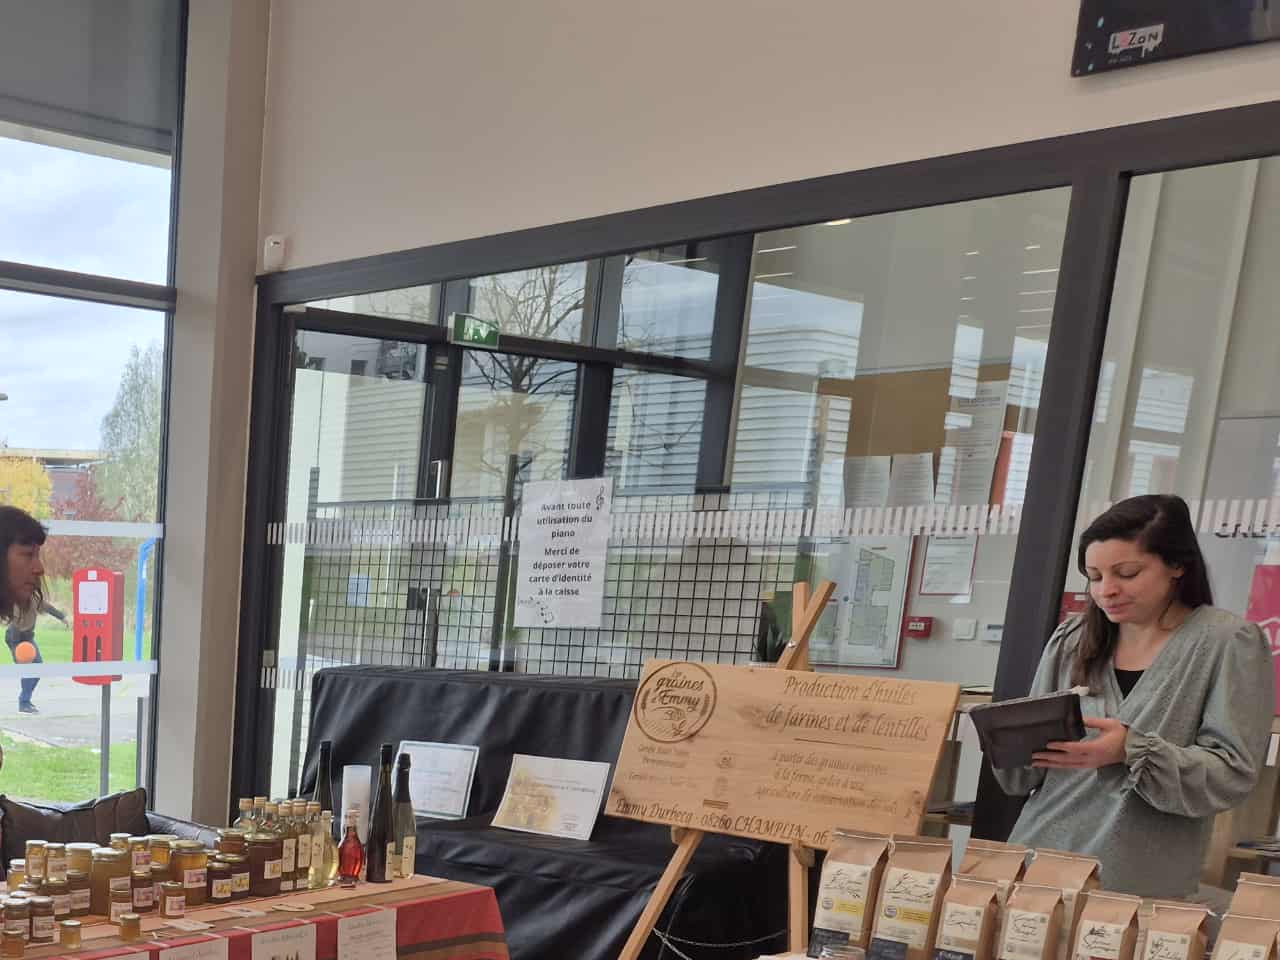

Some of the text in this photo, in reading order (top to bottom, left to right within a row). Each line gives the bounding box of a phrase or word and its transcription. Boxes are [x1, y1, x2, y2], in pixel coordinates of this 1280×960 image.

[541, 503, 565, 511] Avant
[536, 515, 593, 525] utilisation du
[551, 529, 576, 539] piano
[544, 548, 568, 556] Merci
[532, 561, 590, 571] déposer votre
[528, 573, 592, 583] carte d'identité
[538, 586, 580, 596] à la caisse
[784, 675, 858, 700] Production
[782, 705, 831, 732] farines
[834, 714, 850, 733] et
[872, 713, 929, 741] lentilles
